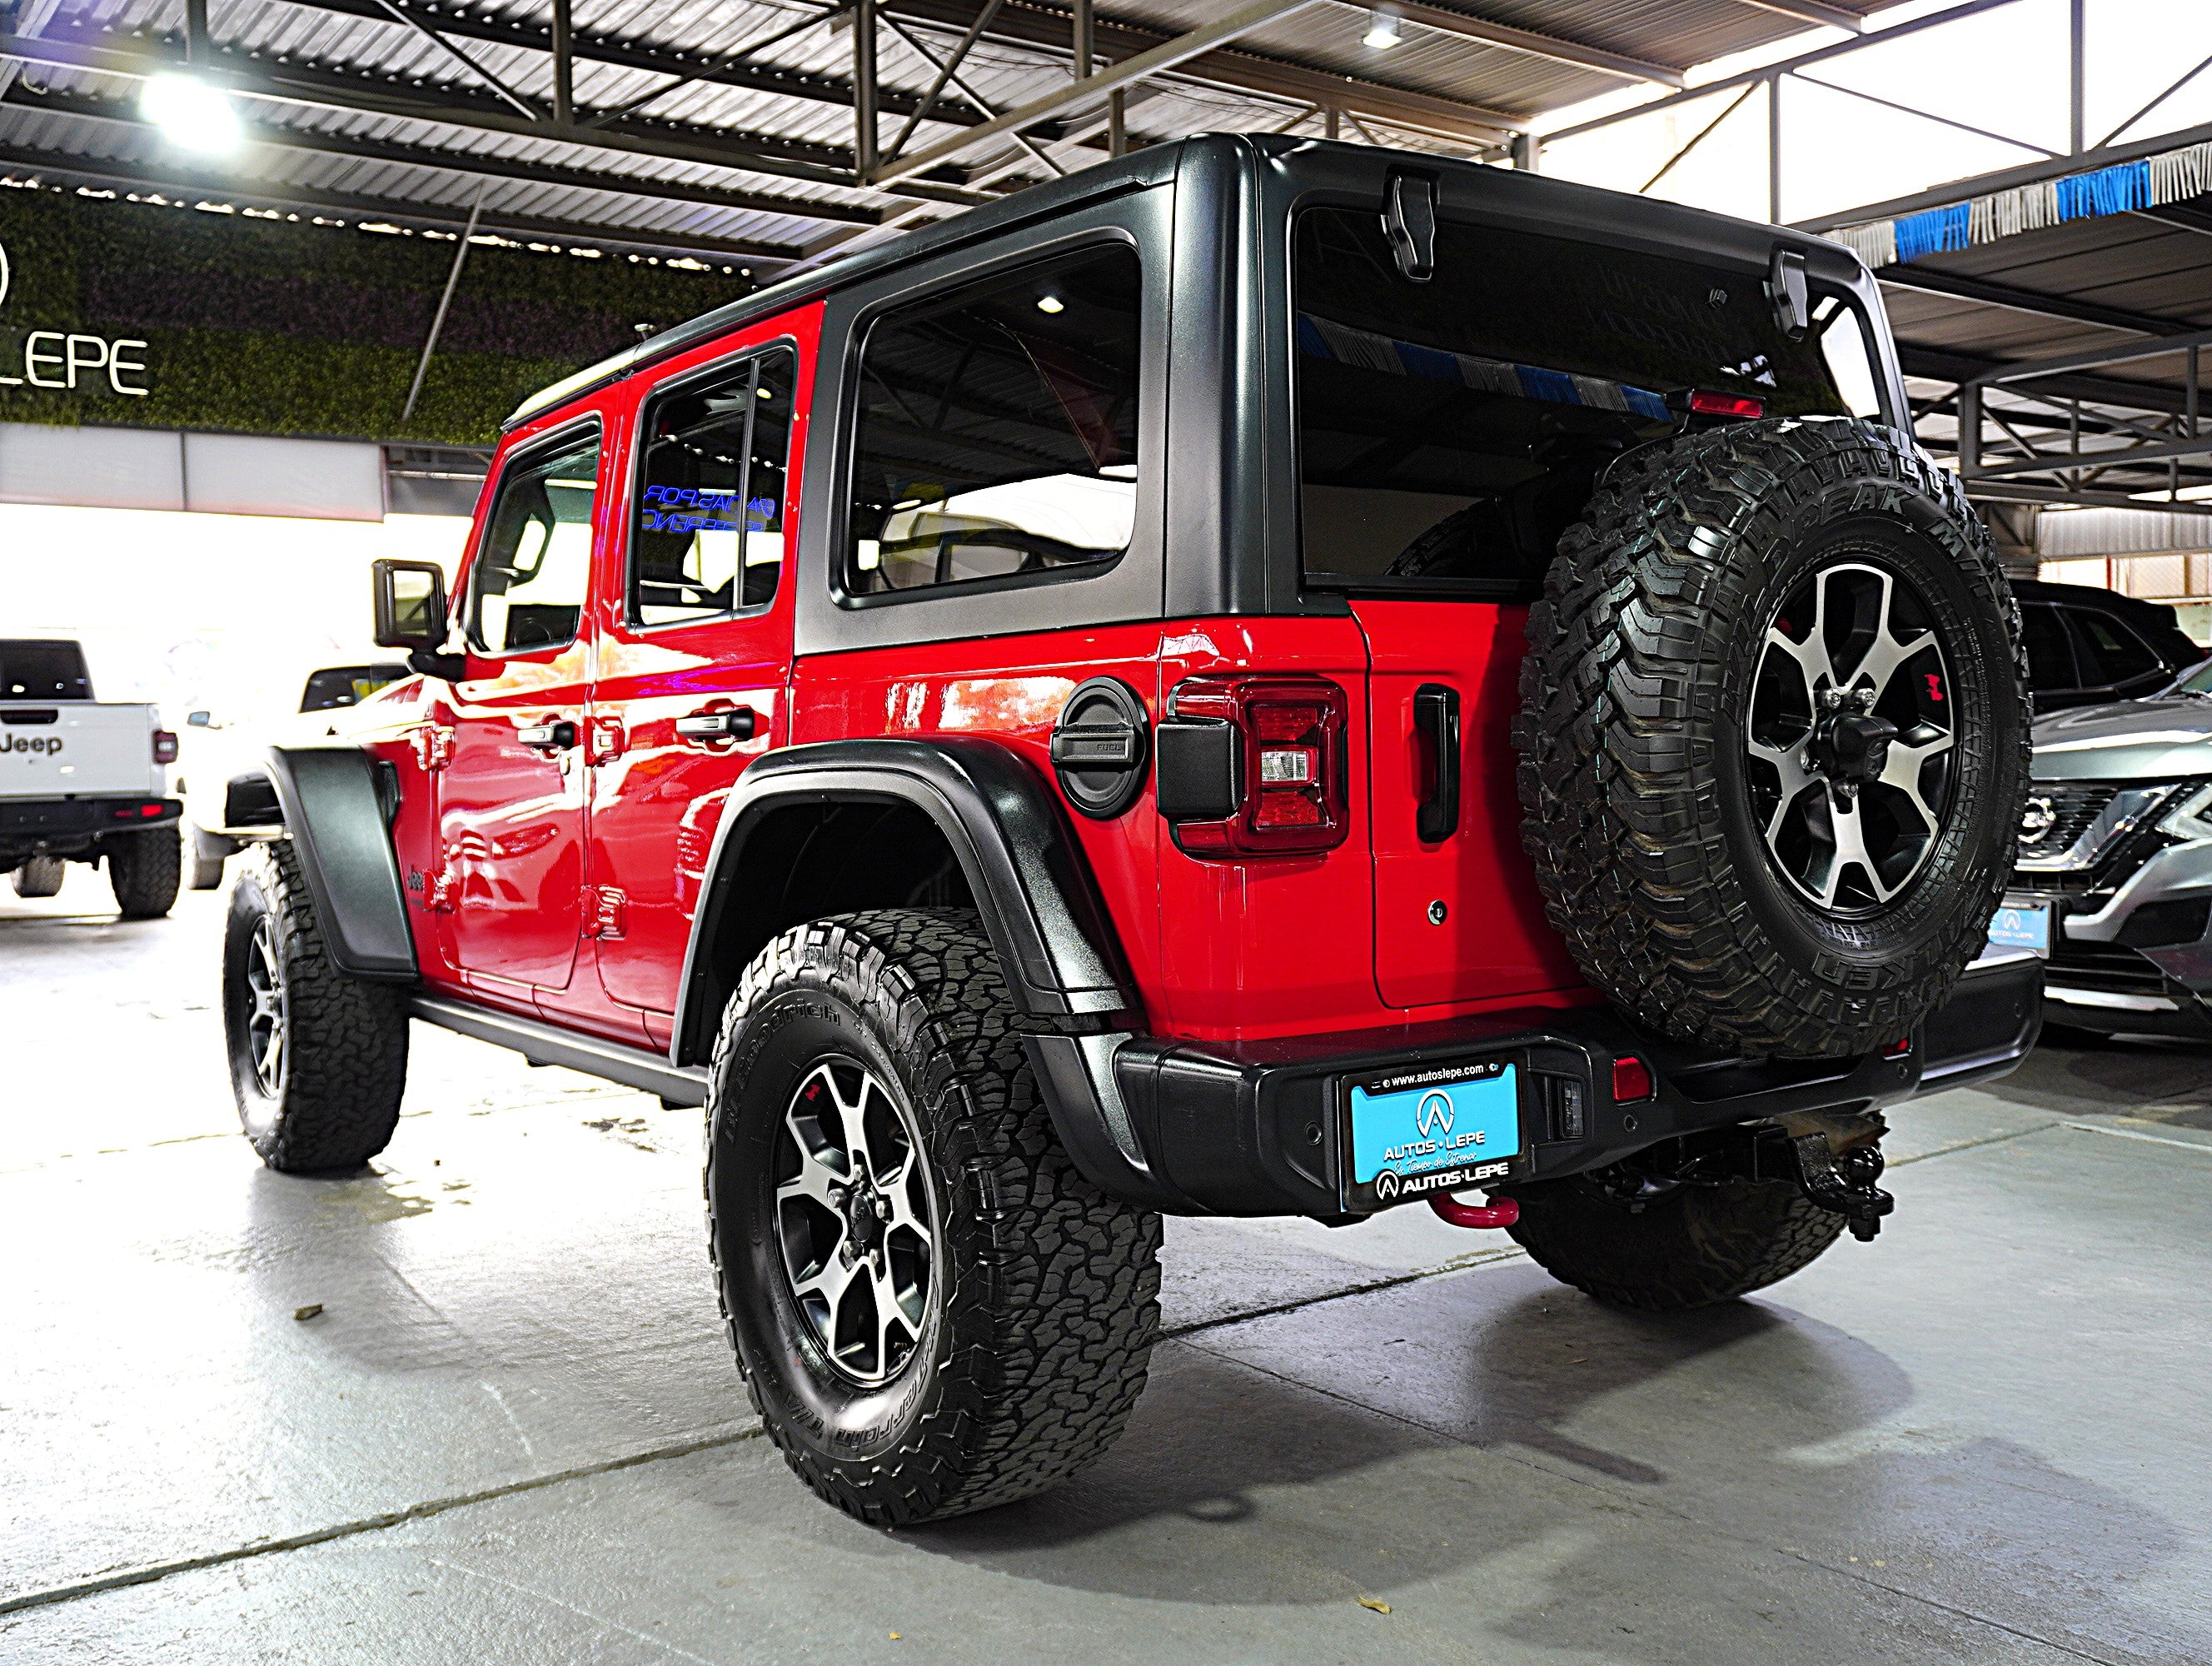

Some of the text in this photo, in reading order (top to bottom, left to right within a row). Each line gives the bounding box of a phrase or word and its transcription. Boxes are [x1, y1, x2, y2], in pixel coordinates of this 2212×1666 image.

[0, 733, 62, 756] Jeep
[1096, 743, 1122, 751] FUEL
[1391, 1065, 1484, 1086] www.autoslepe.com
